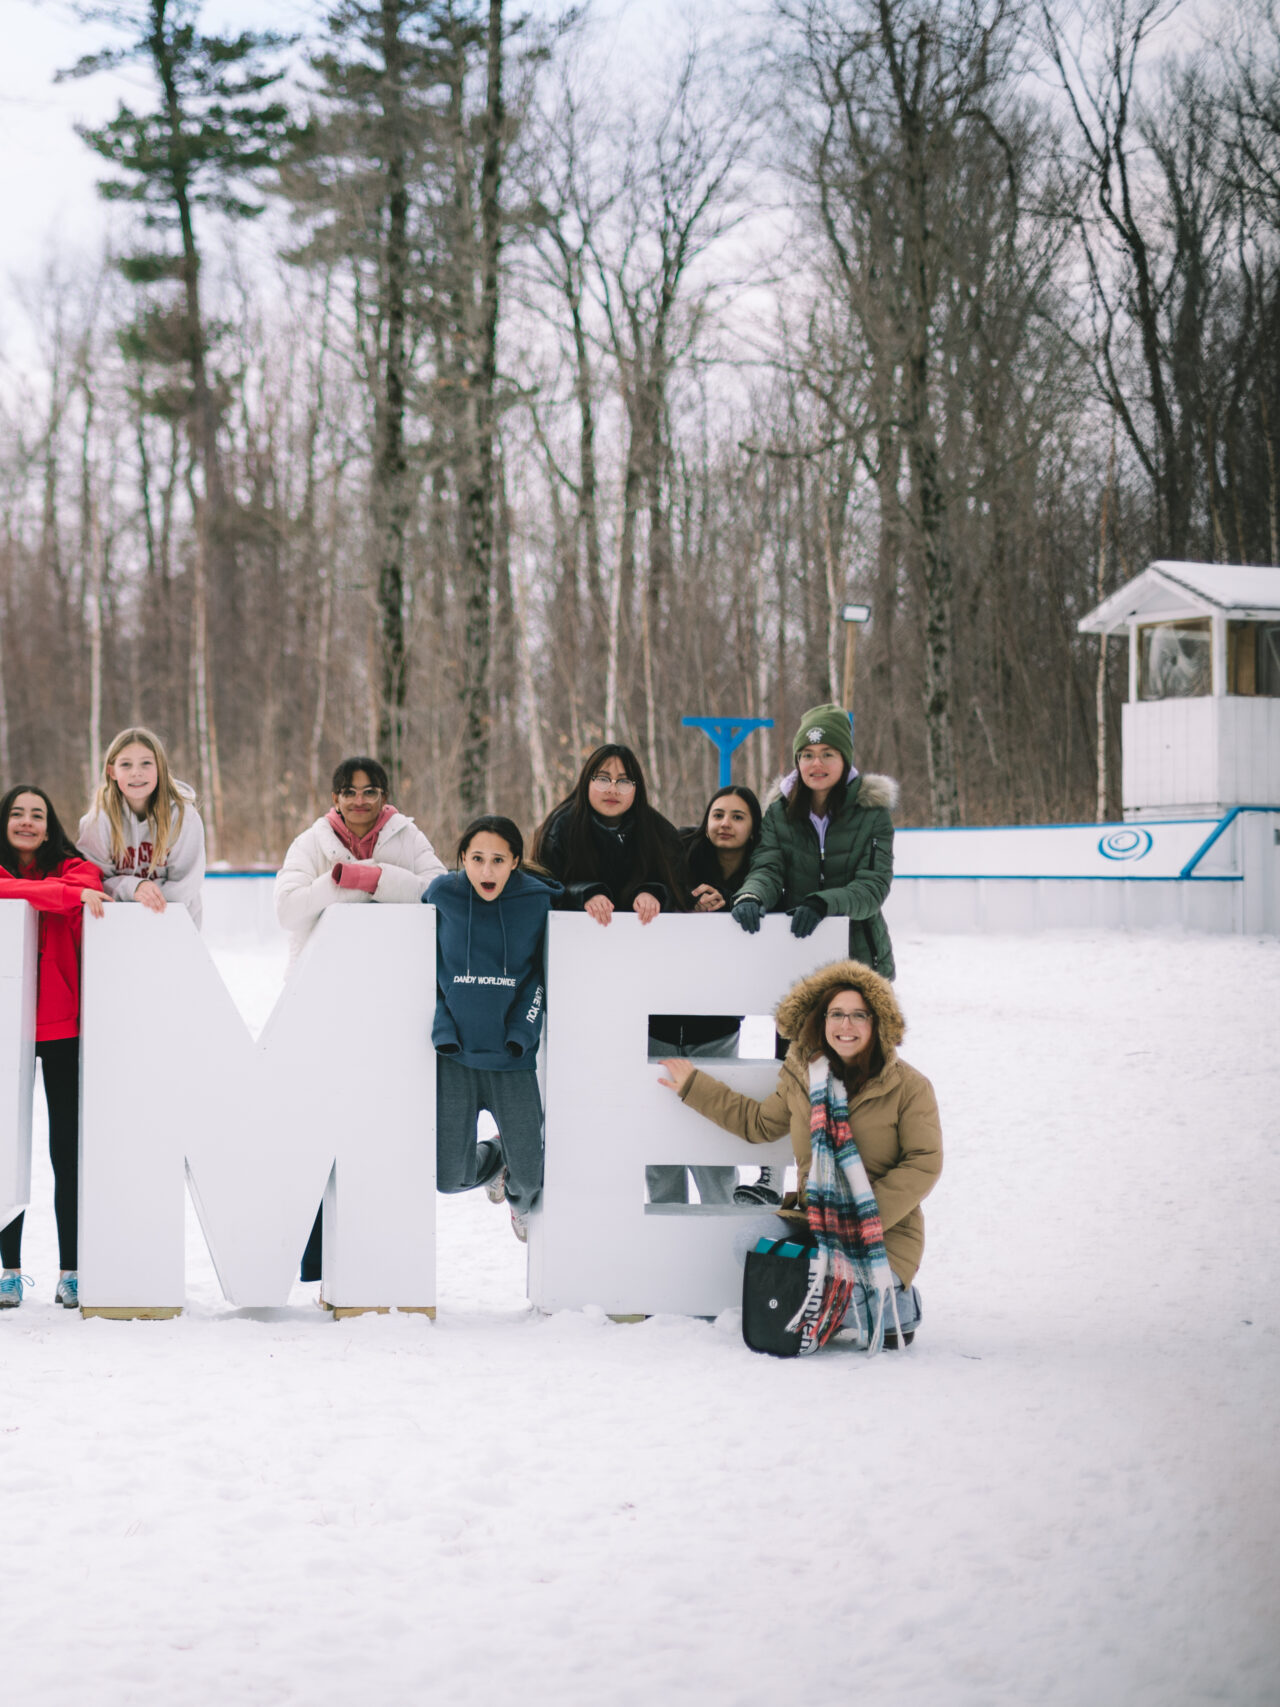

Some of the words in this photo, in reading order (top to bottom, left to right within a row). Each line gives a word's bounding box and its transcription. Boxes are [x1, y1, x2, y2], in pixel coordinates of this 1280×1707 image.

[453, 975, 477, 984] DANDY
[477, 976, 517, 987] WORLDWIDE
[526, 1005, 540, 1024] YOU
